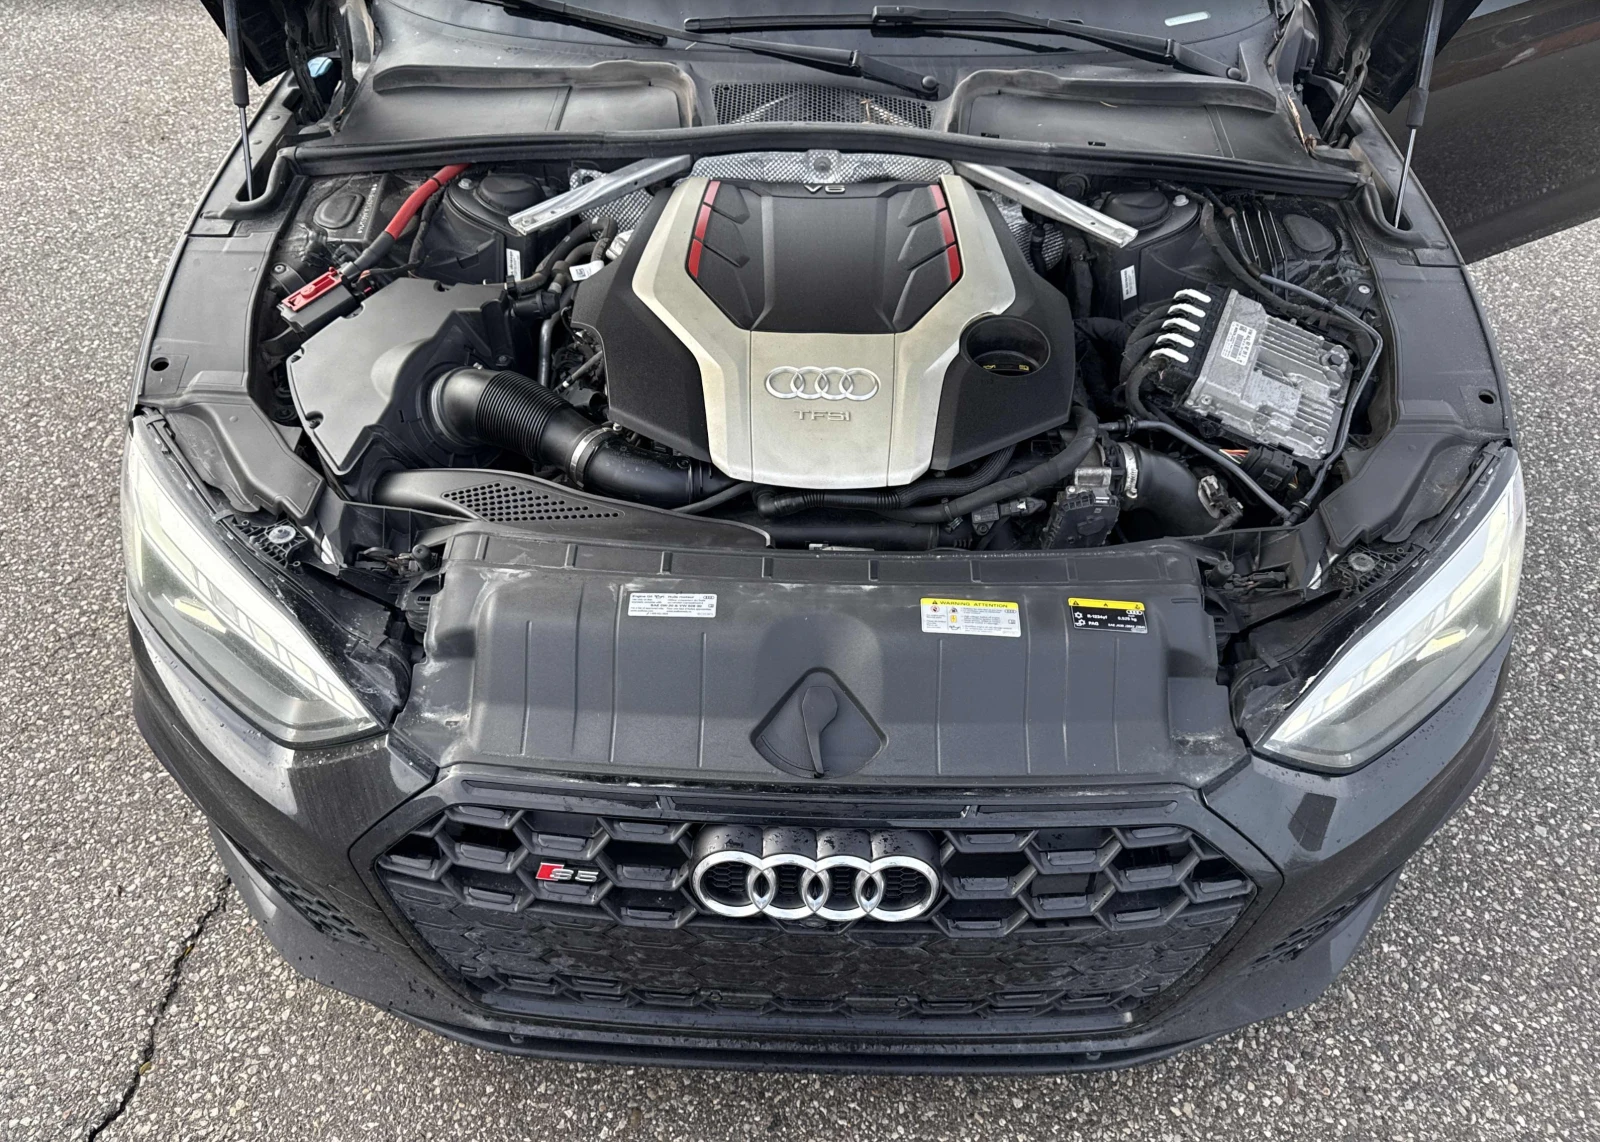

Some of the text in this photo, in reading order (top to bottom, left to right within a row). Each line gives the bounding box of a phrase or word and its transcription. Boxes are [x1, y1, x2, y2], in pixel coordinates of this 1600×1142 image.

[804, 184, 846, 193] V6
[793, 409, 851, 421] TFSI
[549, 867, 598, 882] S5
